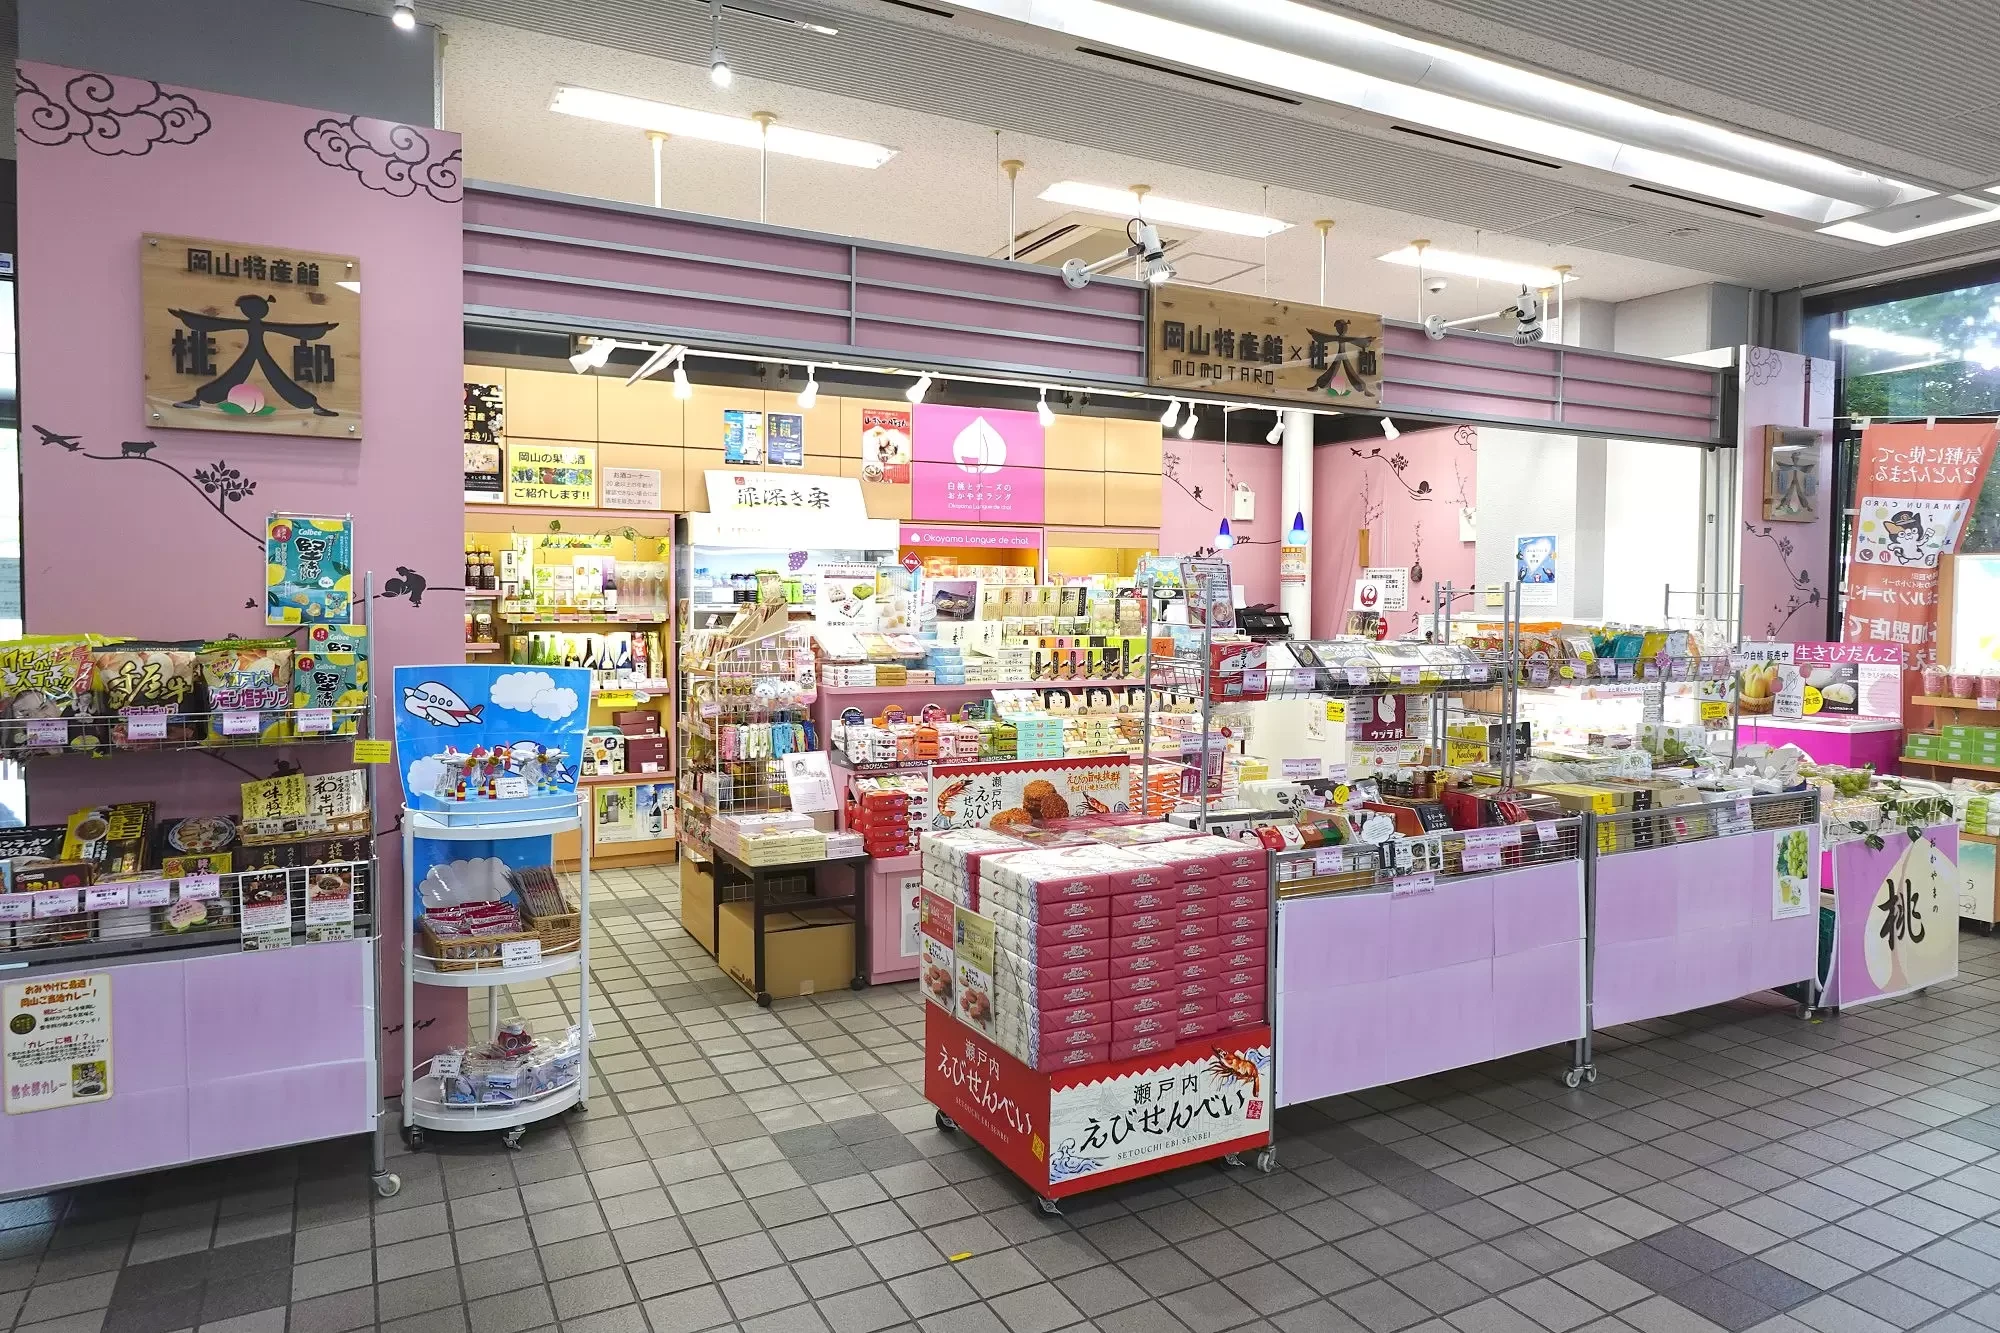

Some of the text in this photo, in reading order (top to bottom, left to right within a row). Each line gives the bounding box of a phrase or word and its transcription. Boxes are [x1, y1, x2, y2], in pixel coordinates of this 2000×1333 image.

[187, 247, 319, 287] 岡山特産館
[1172, 359, 1274, 385] MOMOTARO
[738, 486, 832, 510] 罪深き栗
[947, 481, 1012, 492] 白桃とチーズの
[947, 492, 1012, 502] おかやまラング
[298, 528, 322, 537] Calbee
[924, 533, 1029, 546] Okayama Langue de chat
[1766, 650, 1790, 662] 販売中
[1795, 644, 1899, 662] 生きびだんご
[1066, 770, 1121, 786] えびの旨味抜群
[975, 786, 990, 820] えび
[991, 776, 1003, 811] 瀬戸内
[1929, 837, 1939, 914] おかやまの
[1877, 878, 1926, 951] 桃
[965, 1037, 1000, 1081] 瀬戸内
[937, 1044, 1033, 1135] えびせんべい
[1133, 1074, 1199, 1106] 瀬戸内
[956, 1096, 980, 1121] SETOUCHI
[1080, 1089, 1246, 1153] えびせんべい
[1117, 1131, 1212, 1160] SETOUCHI EBI SENBEI
